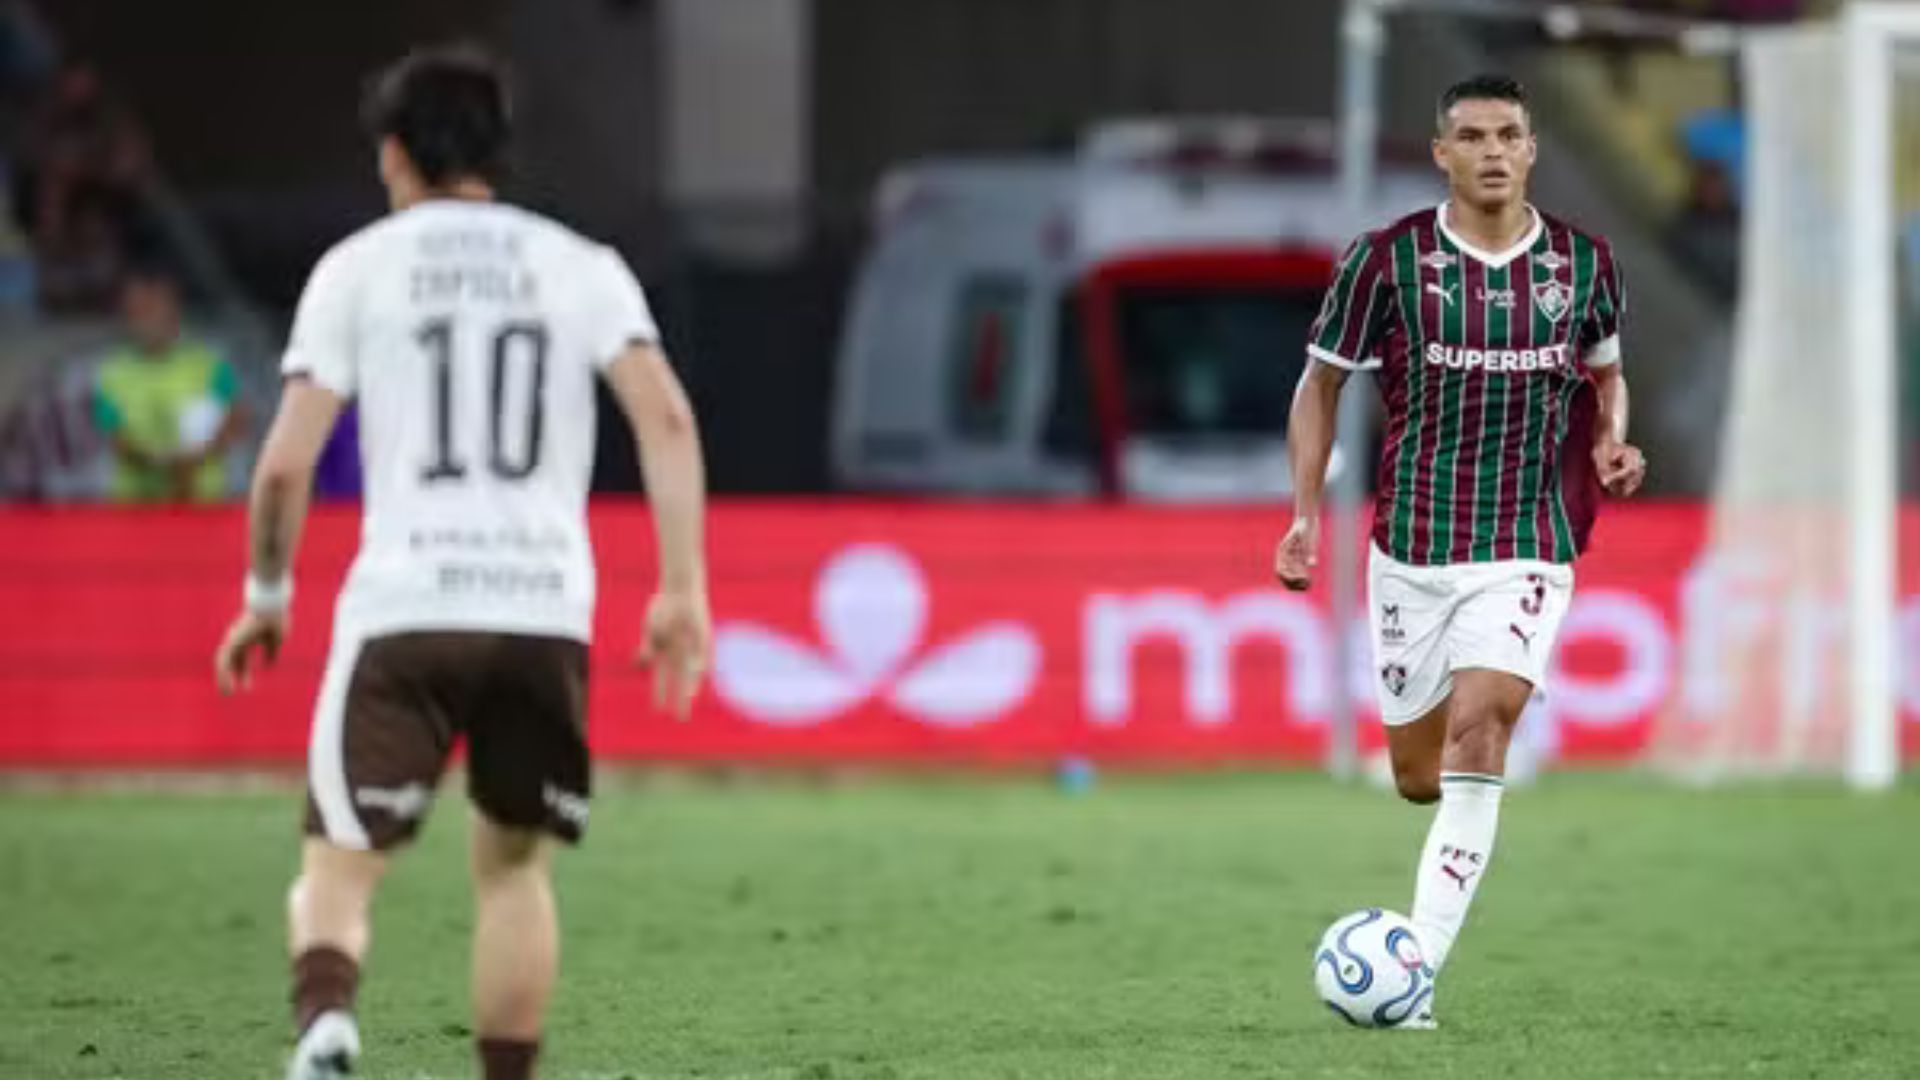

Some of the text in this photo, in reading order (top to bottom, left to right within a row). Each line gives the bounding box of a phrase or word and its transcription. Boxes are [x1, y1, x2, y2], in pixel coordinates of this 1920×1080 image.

[1426, 341, 1568, 372] SUPERBET
[413, 317, 549, 486] 10
[1521, 573, 1545, 615] 3
